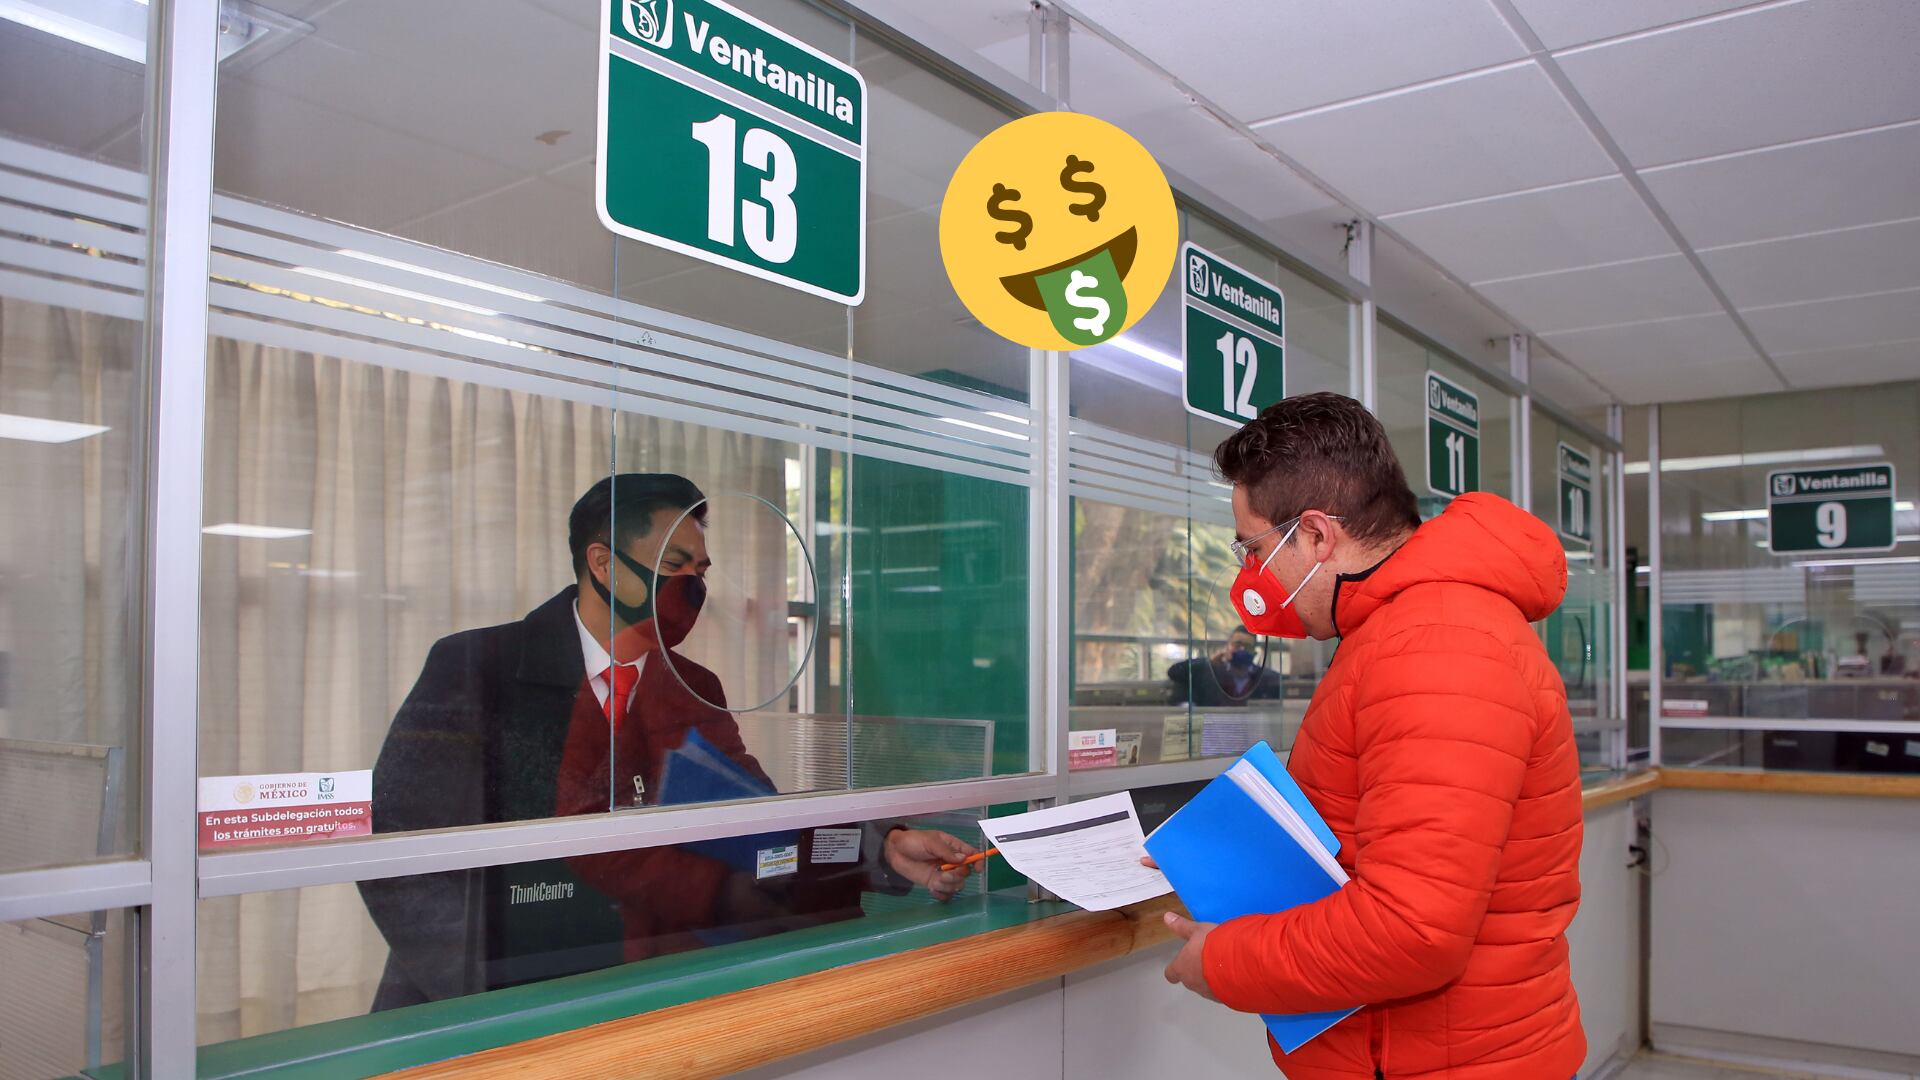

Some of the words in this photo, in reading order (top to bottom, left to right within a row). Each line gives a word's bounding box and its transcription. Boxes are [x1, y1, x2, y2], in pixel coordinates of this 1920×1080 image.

[683, 11, 854, 125] Ventanilla
[692, 113, 798, 264] 13
[1212, 272, 1280, 325] Ventanilla
[1216, 330, 1258, 420] 12
[1446, 432, 1465, 493] 11
[1799, 472, 1888, 490] Ventanilla
[1569, 488, 1584, 537] 10
[1816, 501, 1847, 548] 9
[260, 782, 297, 790] GOBIERNO
[260, 789, 308, 800] MÉXICO
[205, 816, 221, 826] En
[224, 815, 249, 825] esta
[251, 808, 332, 823] Subdelegación
[334, 806, 364, 817] todos
[214, 830, 231, 840] los
[233, 826, 282, 839] trámites
[283, 825, 304, 835] son
[510, 881, 574, 905] ThinkCentre
